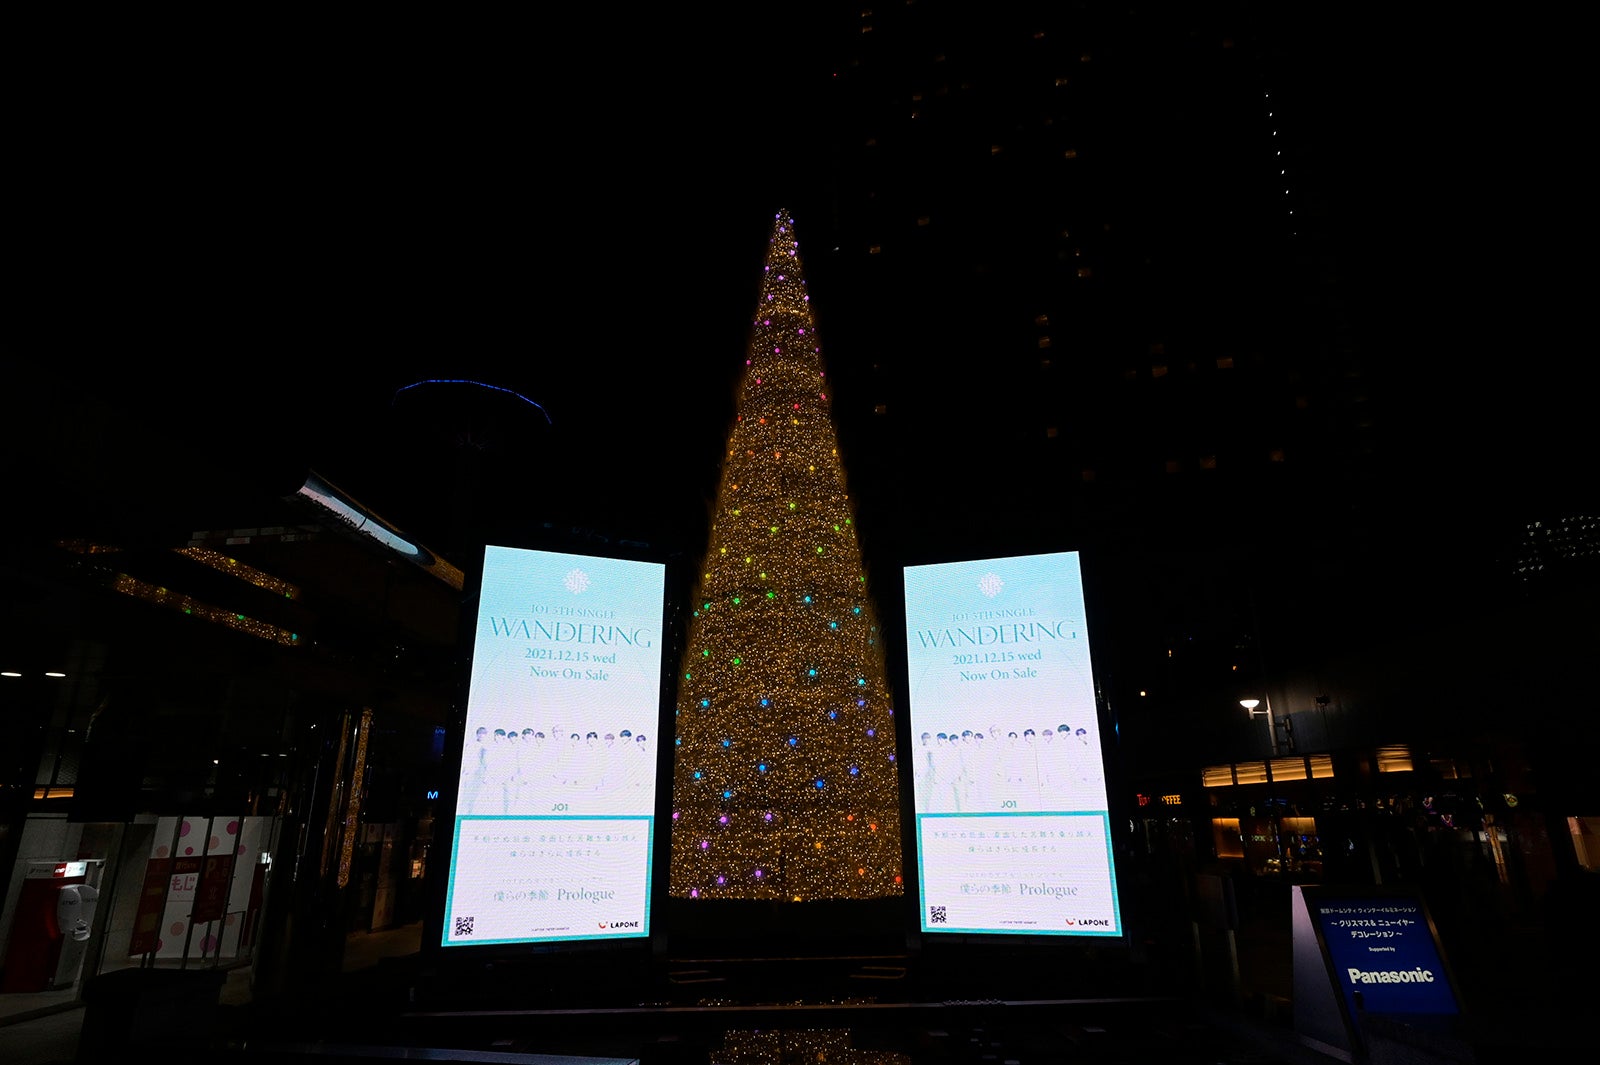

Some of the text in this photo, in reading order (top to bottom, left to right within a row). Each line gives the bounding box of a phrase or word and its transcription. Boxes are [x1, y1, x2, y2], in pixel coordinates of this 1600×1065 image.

[577, 607, 616, 619] SINGLE
[994, 607, 1035, 619] SINGLE
[491, 616, 652, 648] WANDERING
[917, 620, 1076, 648] WANDERING
[525, 648, 616, 664] 2021.12.15 wed
[952, 649, 1042, 665] 2021.12.15 wed
[530, 666, 609, 681] Now On Sale
[960, 667, 1037, 681] Now On Sale
[552, 803, 569, 812] JO1
[1000, 800, 1017, 809] JO1
[557, 887, 616, 904] Prologue
[1019, 883, 1078, 899] Prologue
[610, 921, 639, 929] LAPONE
[1078, 919, 1109, 927] LAPONE
[1348, 967, 1434, 984] Panasonic
